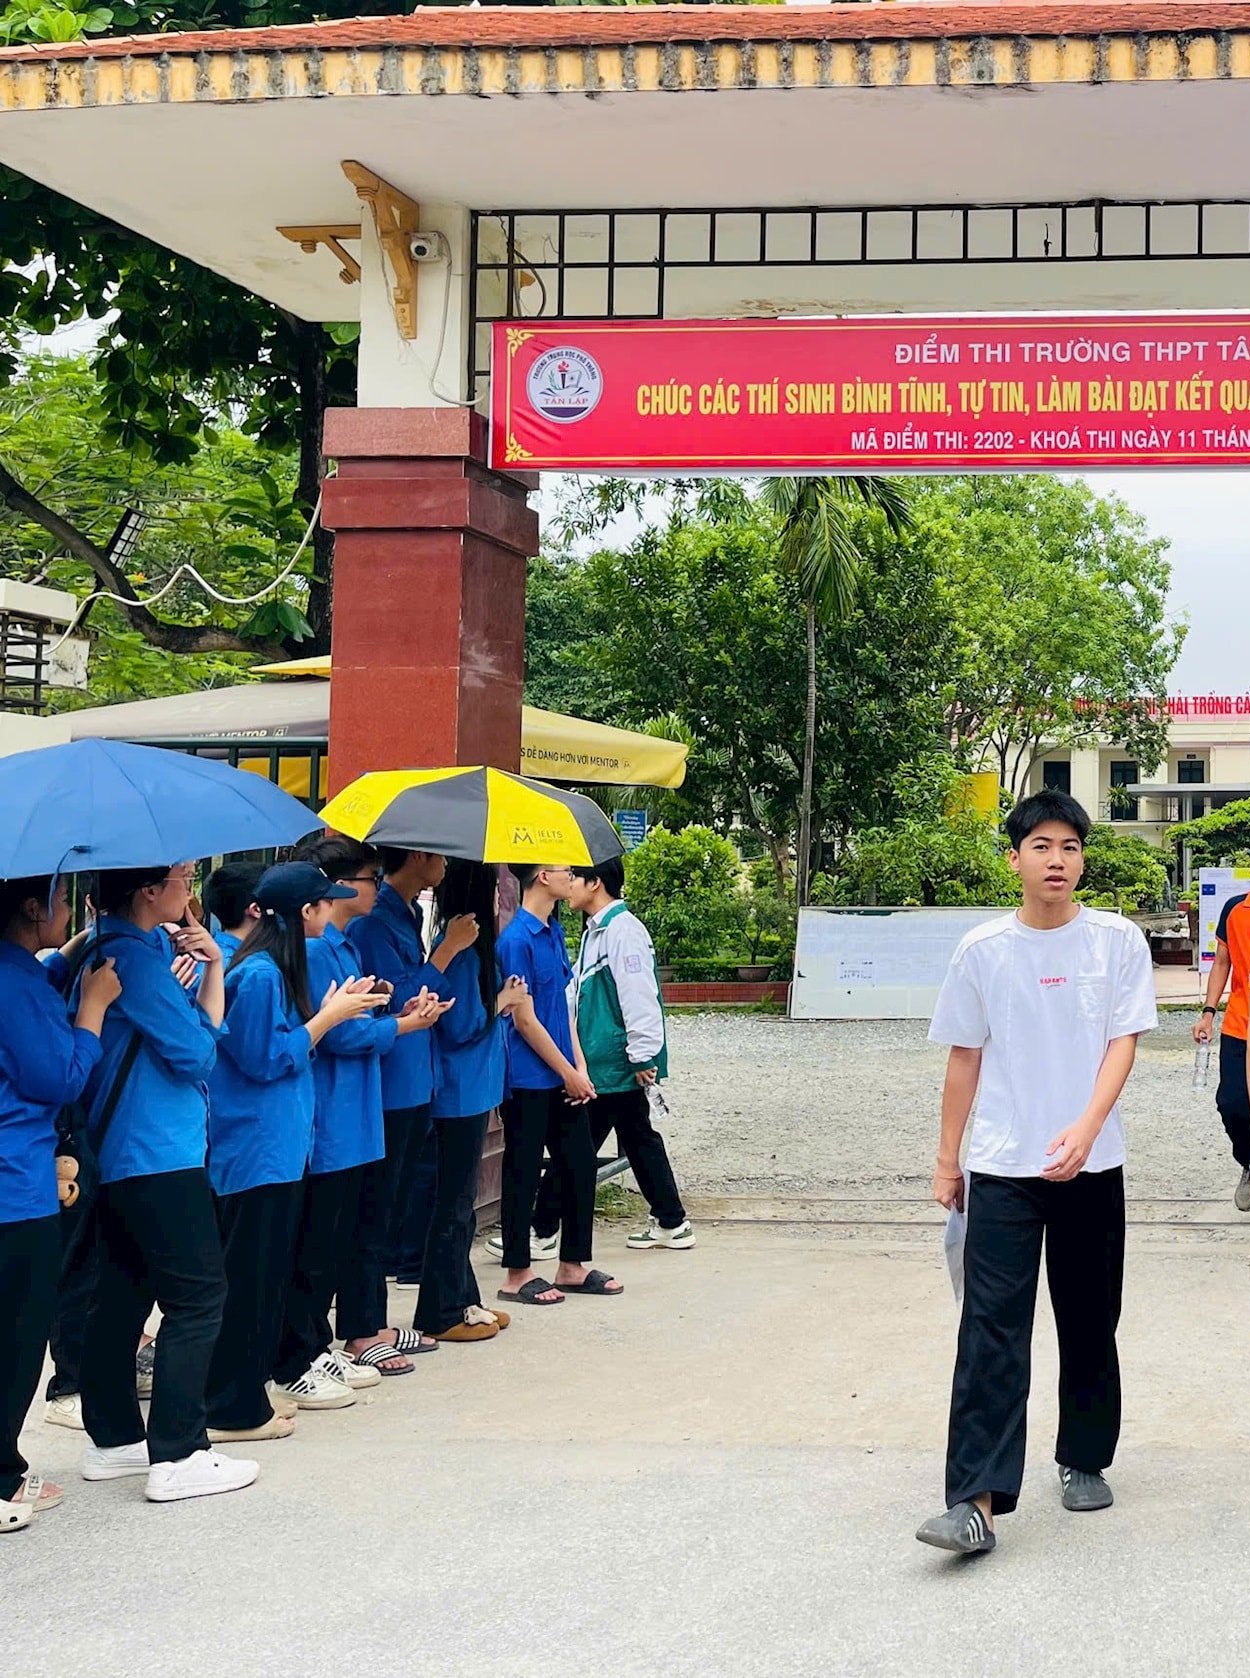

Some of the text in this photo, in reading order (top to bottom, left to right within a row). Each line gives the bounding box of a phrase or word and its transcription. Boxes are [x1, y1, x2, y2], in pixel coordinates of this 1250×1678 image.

[895, 333, 959, 363] ĐIỂM
[969, 343, 1010, 363] THI
[1019, 337, 1130, 363] TRƯỜNG
[1139, 341, 1208, 362] THPT
[637, 378, 692, 415] CHÚC
[699, 378, 740, 415] CÁC
[746, 377, 779, 414] THÍ
[785, 383, 835, 414] SINH
[842, 377, 892, 414] BÌNH
[898, 376, 952, 416] TĨNH,
[958, 379, 987, 419] TỰ
[990, 382, 1030, 416] TIN,
[1037, 375, 1081, 413] LÀM
[1088, 375, 1122, 412] BÀI
[1129, 381, 1169, 418] ĐẠT
[1176, 369, 1213, 411] KẾT
[852, 427, 878, 450] MÃ
[884, 421, 927, 450] ĐIỂM
[934, 431, 967, 449] THI:
[974, 431, 1013, 450] 2202
[1031, 425, 1081, 450] KHOÁ
[1087, 430, 1115, 449] THI
[1122, 425, 1171, 449] NGÀY
[1178, 430, 1195, 448] 11
[1162, 690, 1188, 714] HẢI
[1192, 690, 1232, 715] TRỒNG
[590, 756, 619, 768] MENTOR
[538, 830, 563, 839] IELTS
